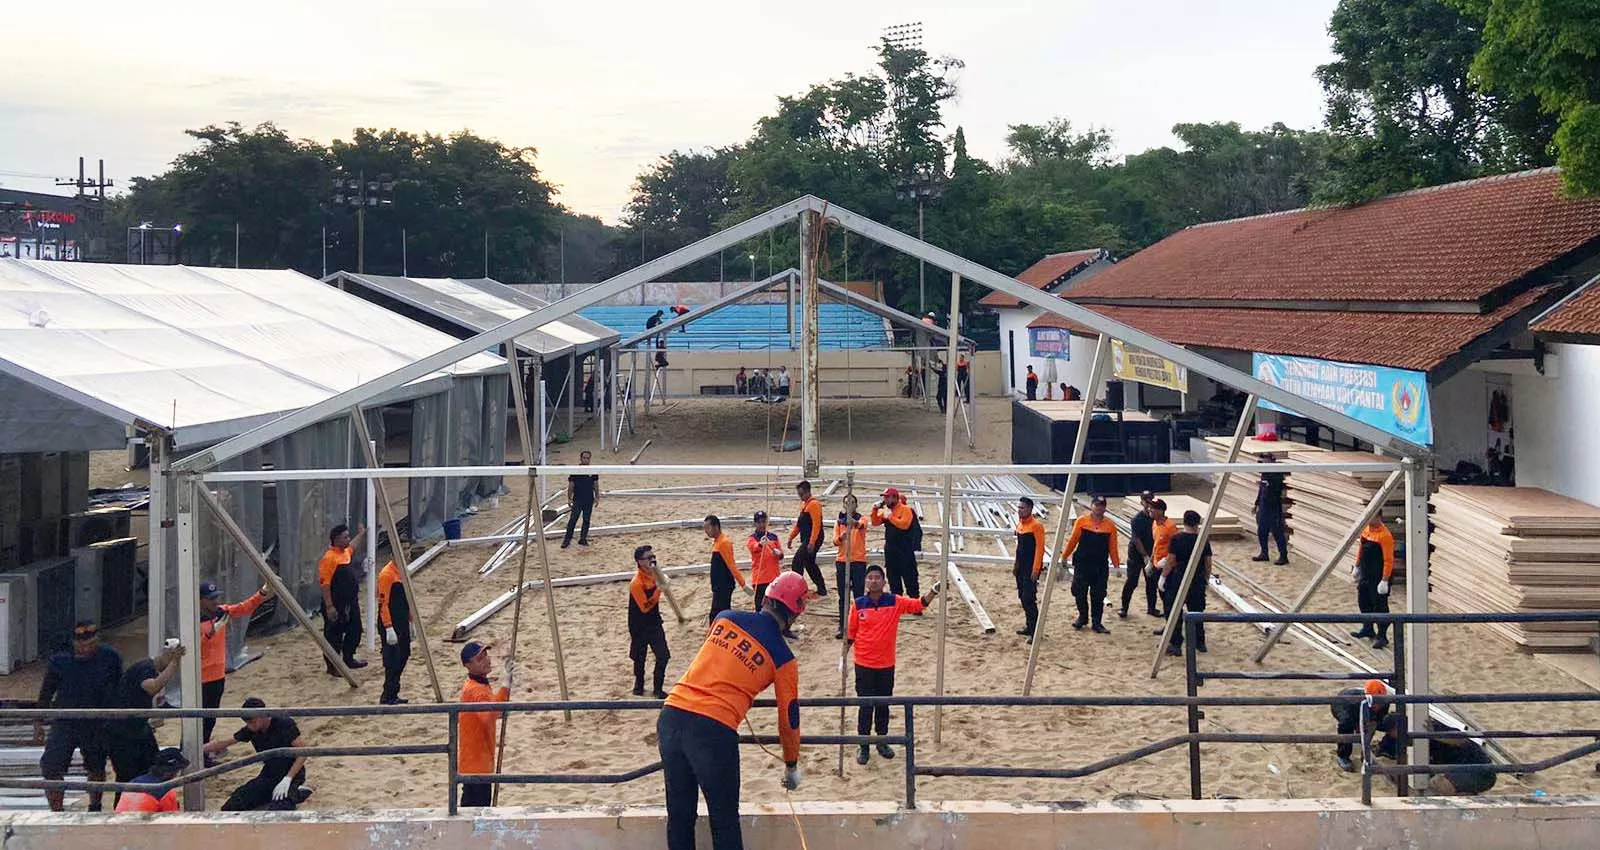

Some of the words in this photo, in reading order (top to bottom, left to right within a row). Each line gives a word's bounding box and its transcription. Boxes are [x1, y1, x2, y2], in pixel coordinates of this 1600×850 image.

[1354, 389, 1385, 410] PANTAI
[713, 625, 765, 666] BPBD
[731, 648, 757, 673] TIMUR
